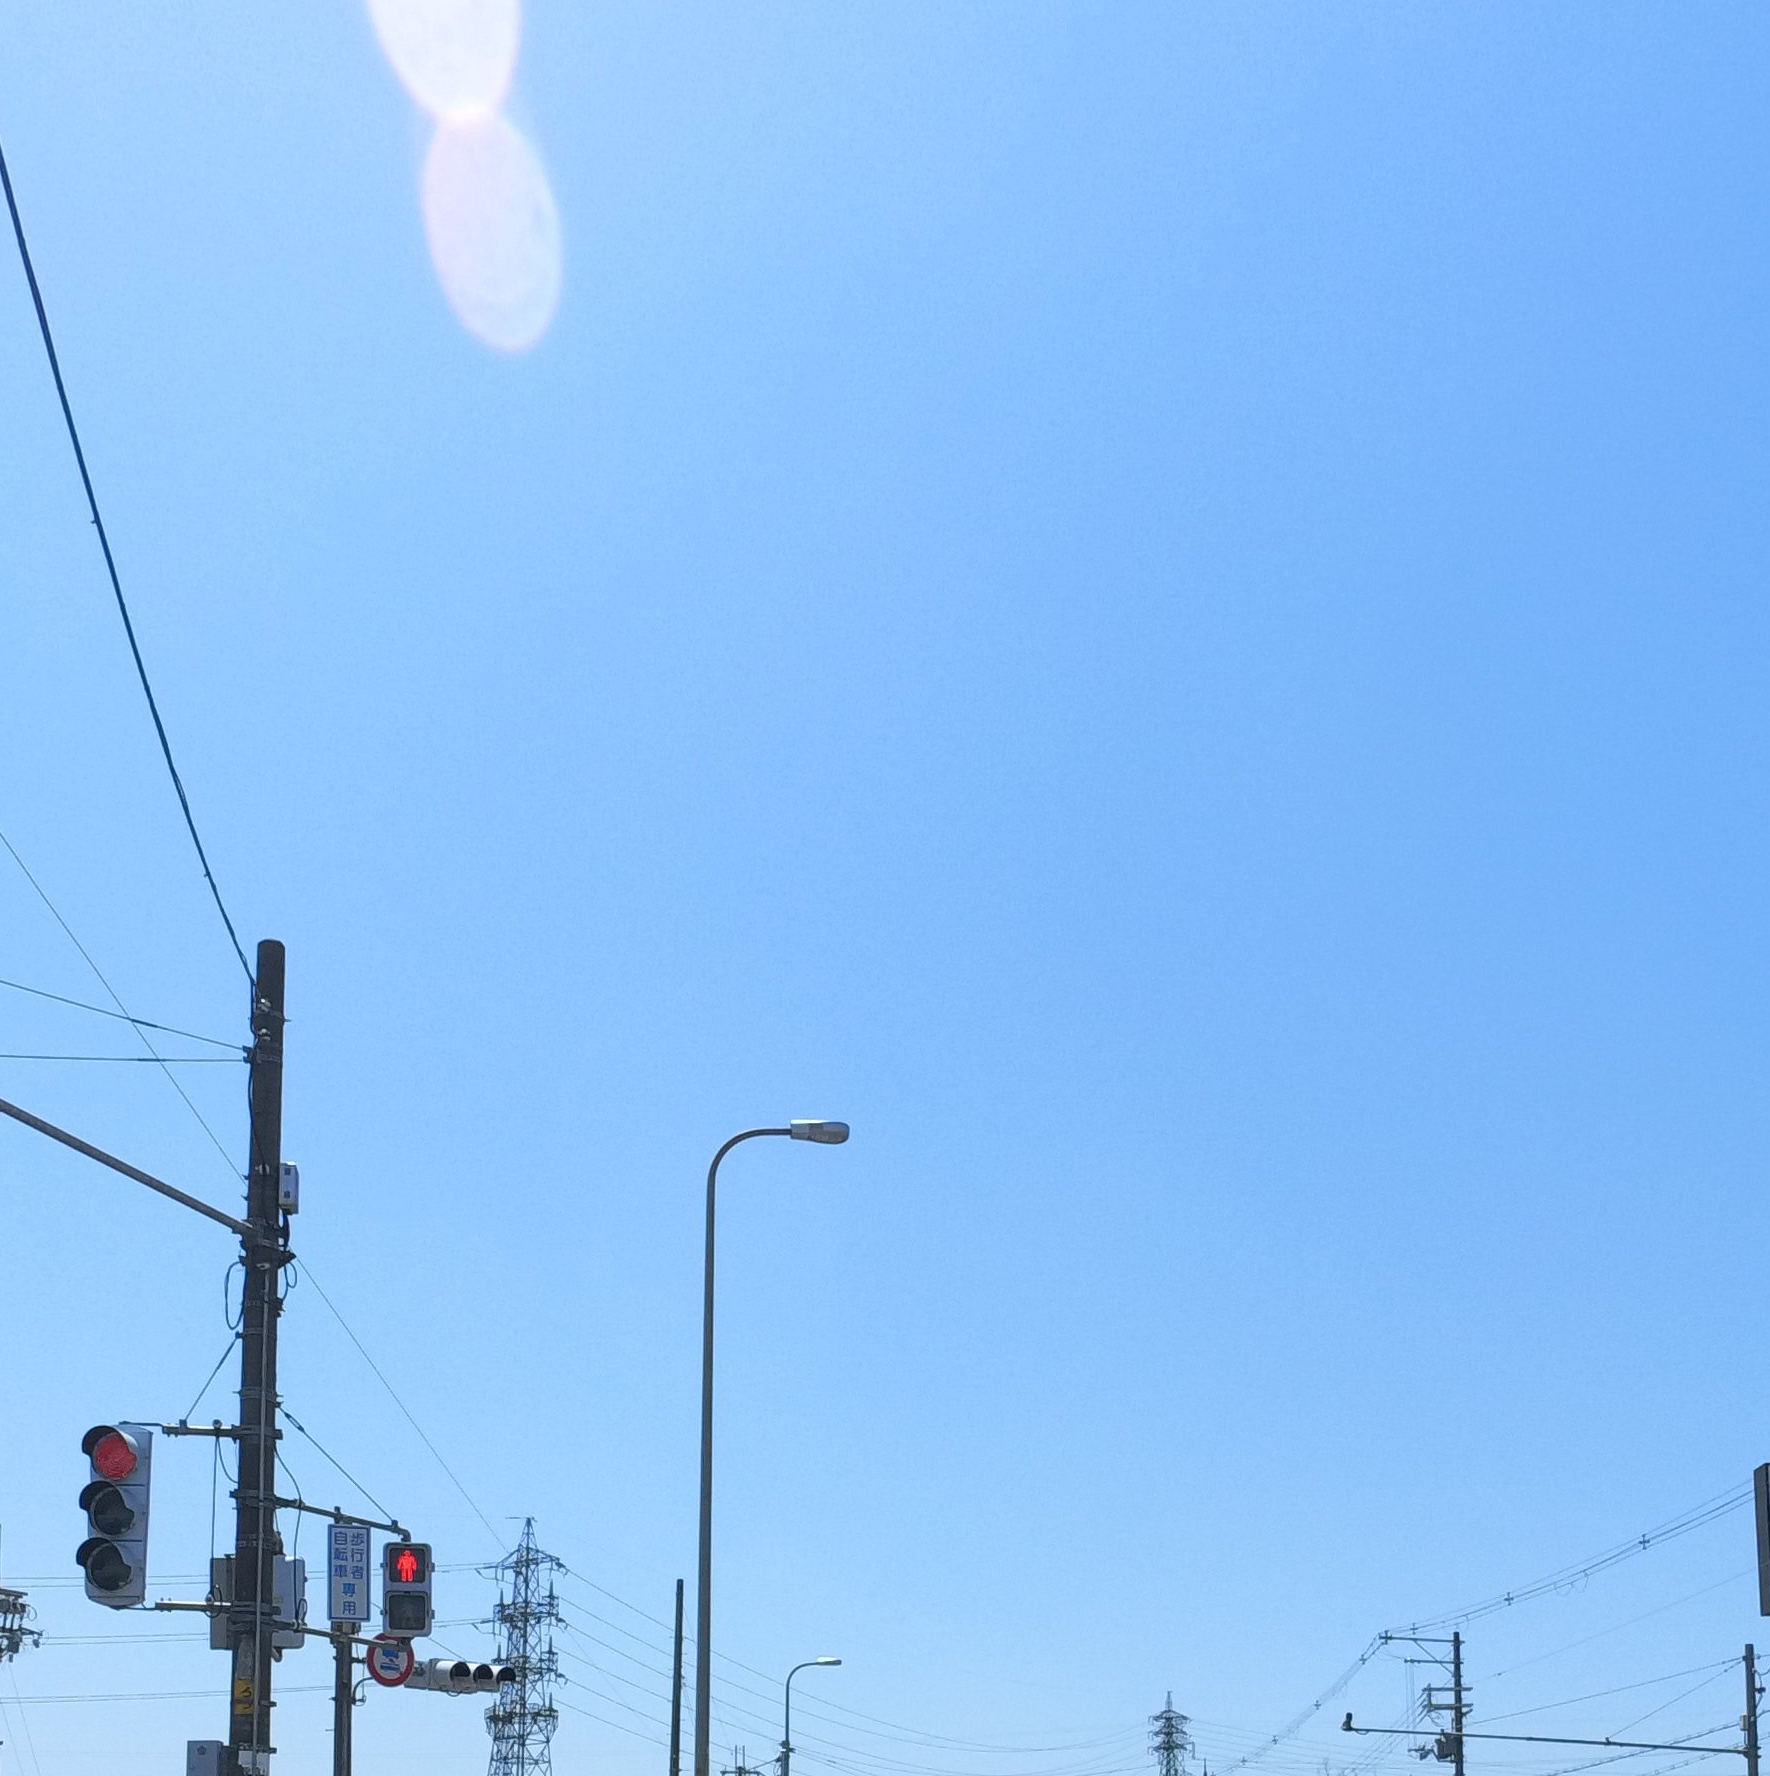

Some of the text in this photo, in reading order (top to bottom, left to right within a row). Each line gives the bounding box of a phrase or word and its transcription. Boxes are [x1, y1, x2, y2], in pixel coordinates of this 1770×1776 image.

[333, 1531, 348, 1578] 自転車
[350, 1531, 365, 1580] 歩行者
[342, 1582, 356, 1616] 専用
